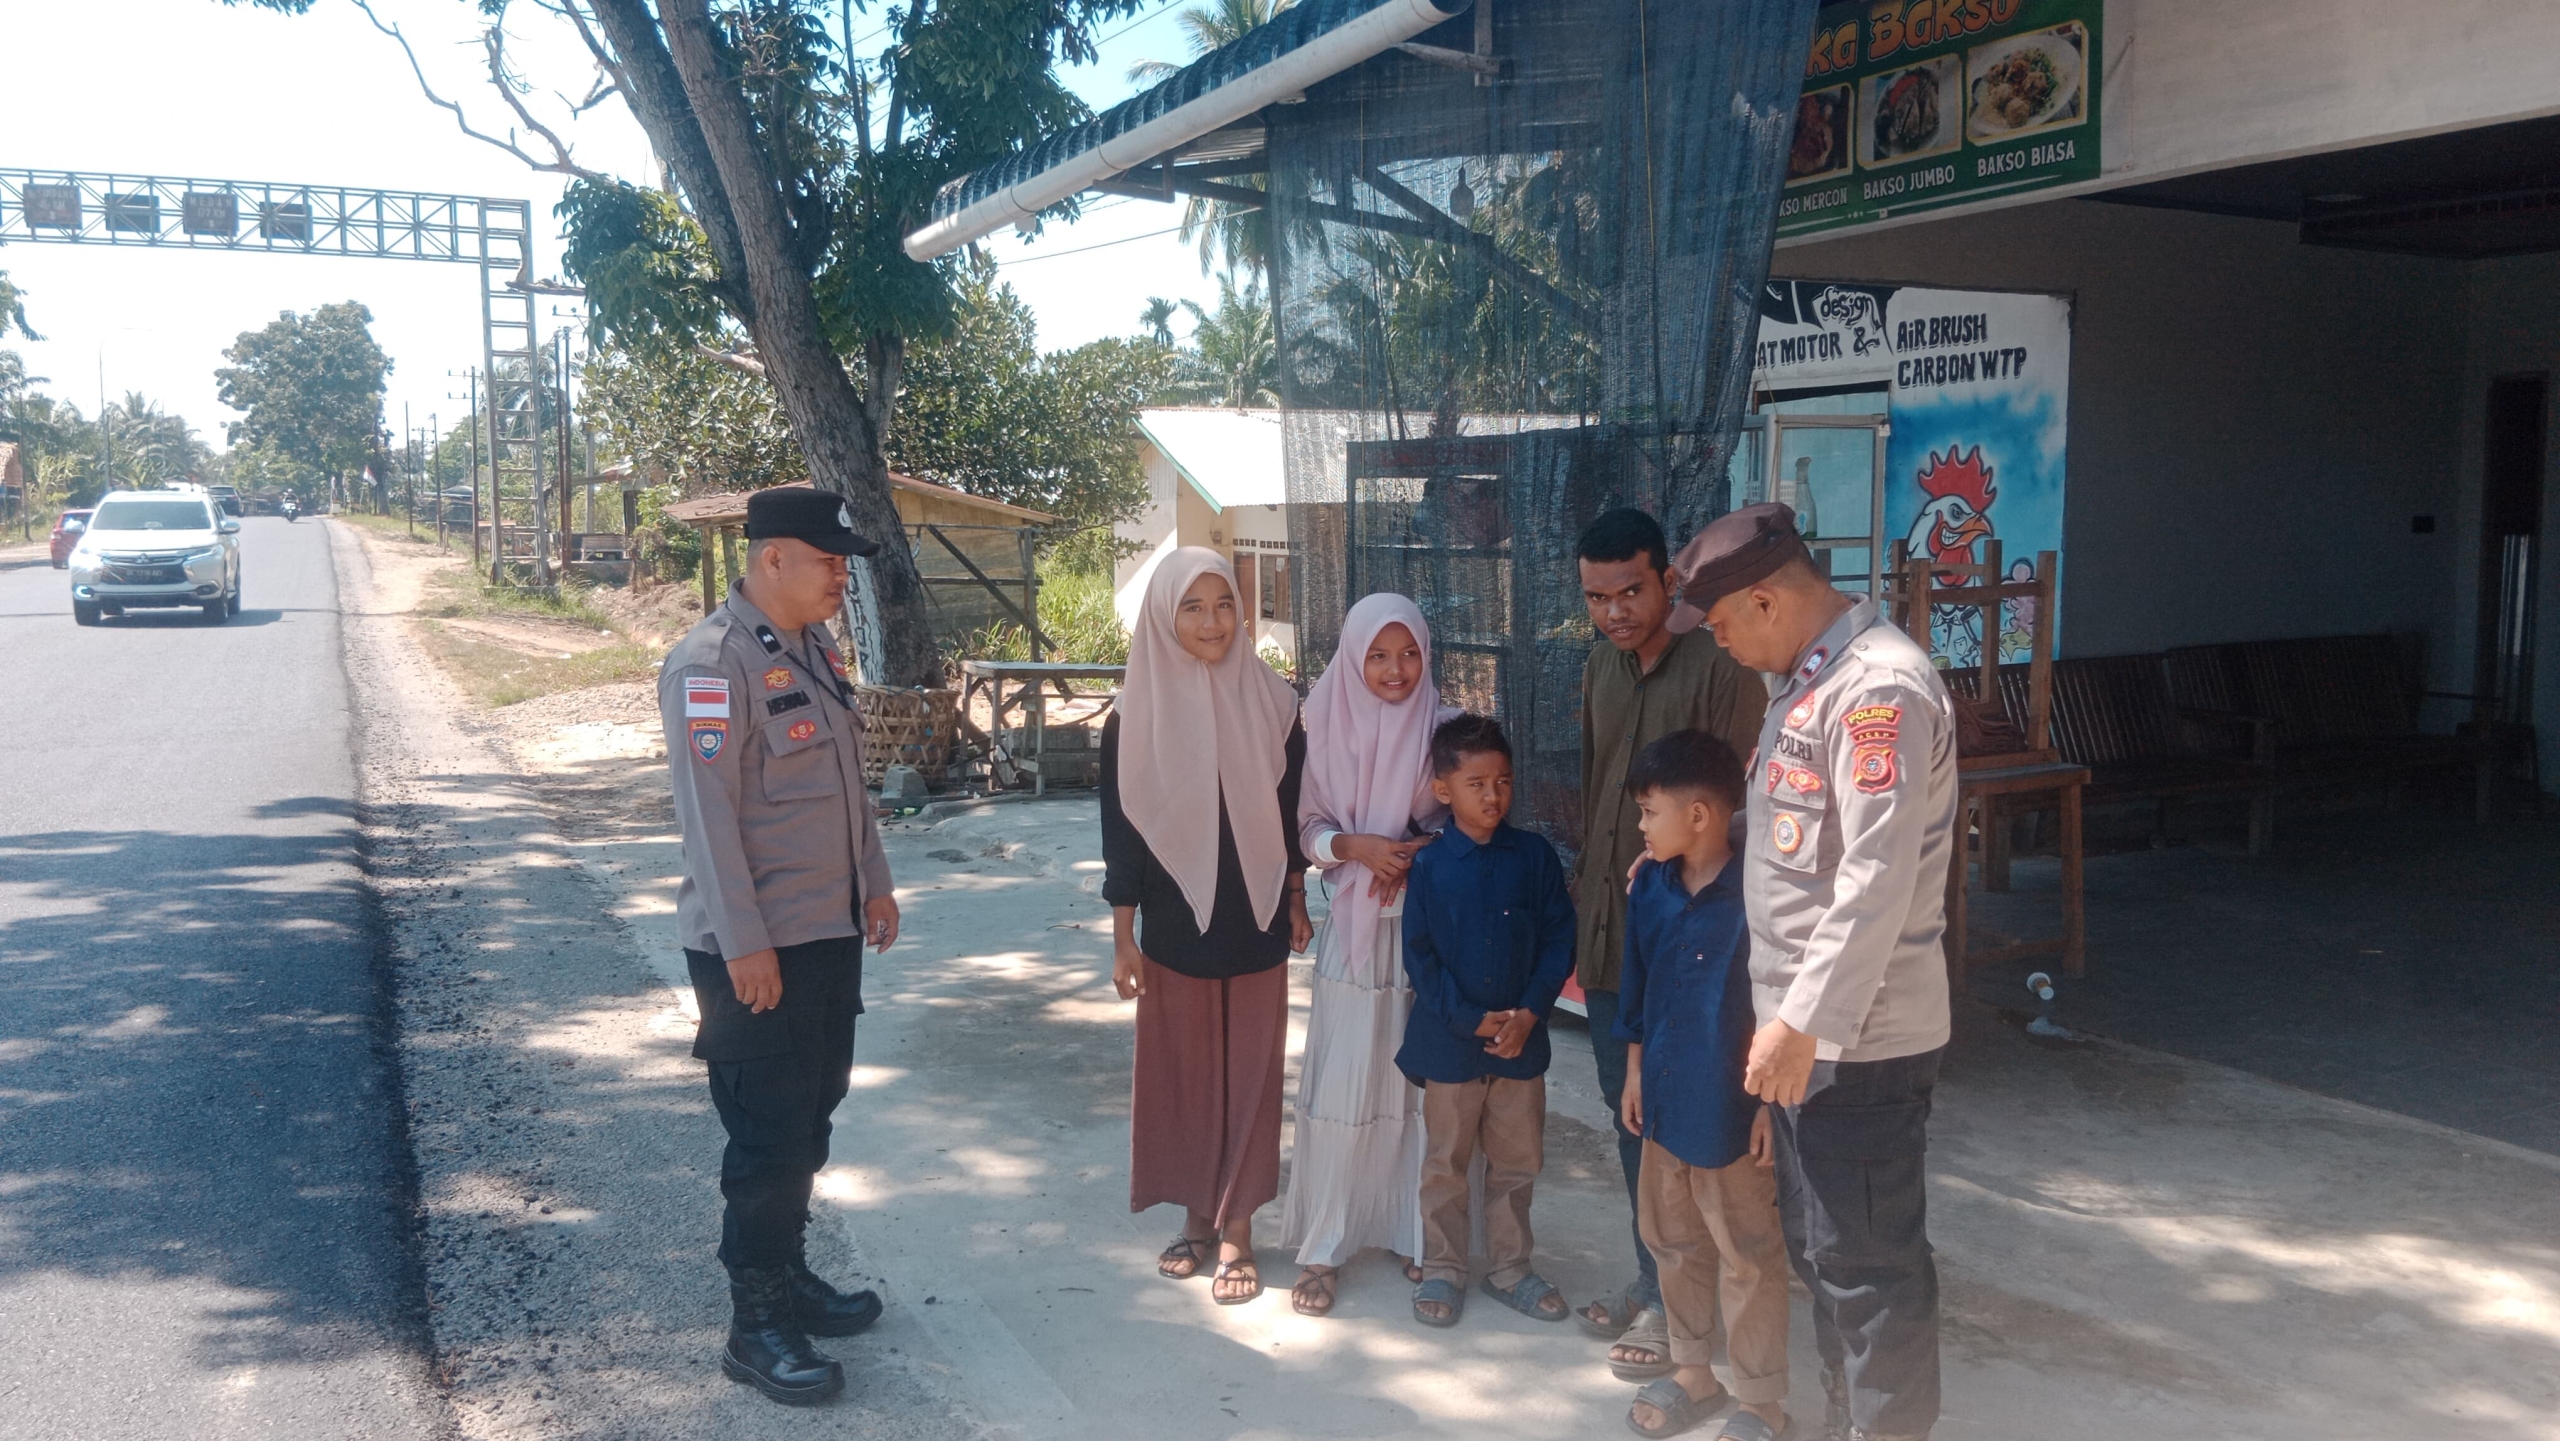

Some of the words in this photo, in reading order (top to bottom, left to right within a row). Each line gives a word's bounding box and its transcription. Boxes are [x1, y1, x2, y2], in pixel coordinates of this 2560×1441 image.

[1977, 150, 2026, 177] BAKSO
[2030, 139, 2076, 167] BIASA
[1862, 174, 1906, 201] BAKSO
[1909, 164, 1956, 192] JUMBO
[189, 195, 232, 208] MEDAN
[1803, 186, 1848, 213] MERCON
[1820, 286, 1882, 330] design
[1753, 340, 1778, 369] AT
[1780, 331, 1842, 365] MOTOR
[1897, 352, 1976, 389] CARBON
[1979, 346, 2028, 381] WTP
[688, 679, 726, 687] INDONESIA
[1847, 707, 1894, 724] POLRES
[1774, 730, 1813, 761] POLRI
[1858, 731, 1890, 741] ACEH
